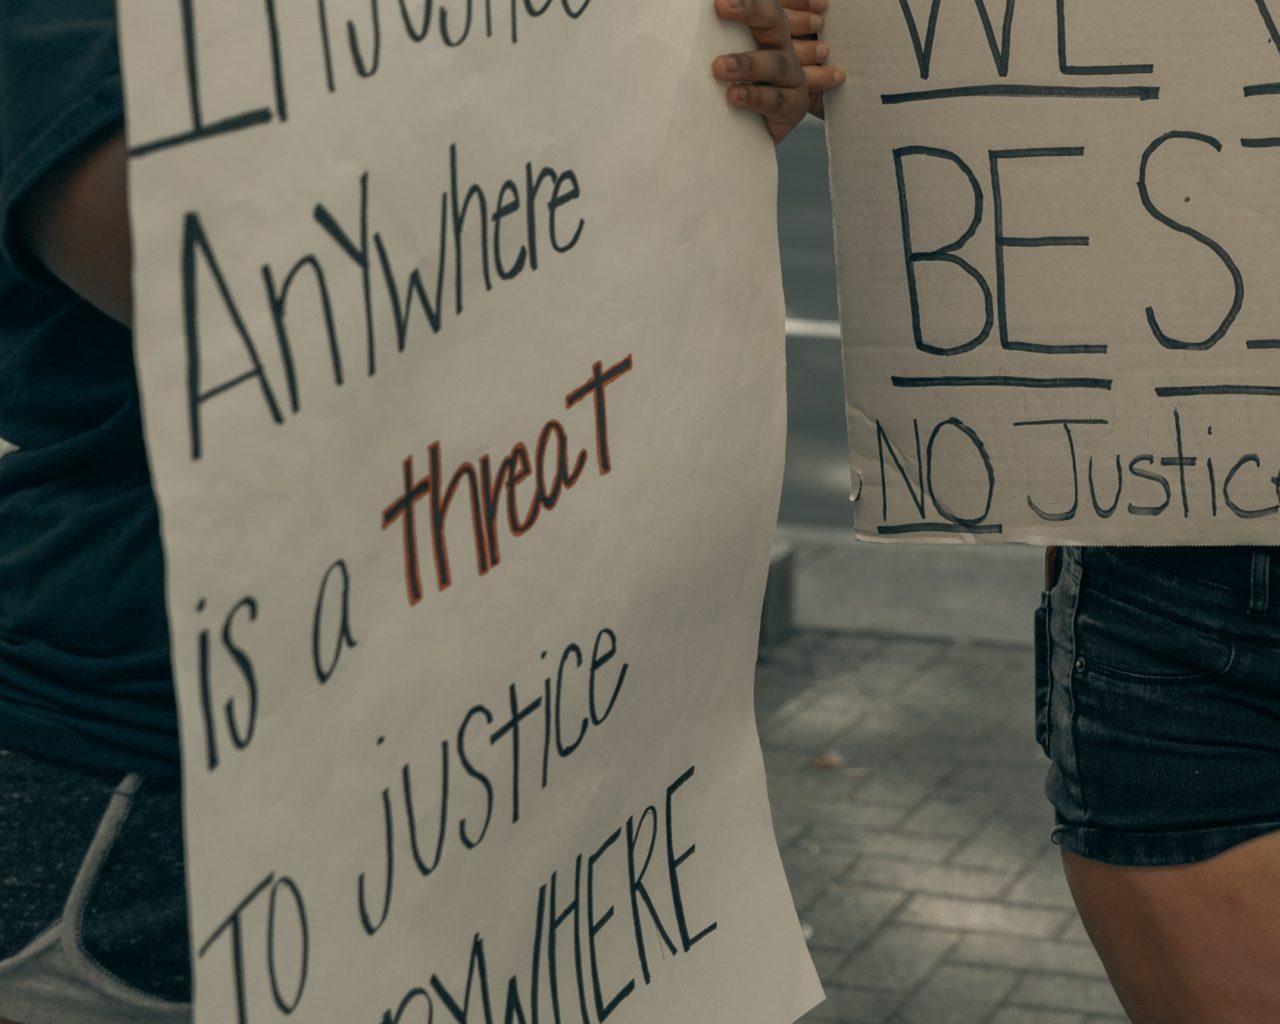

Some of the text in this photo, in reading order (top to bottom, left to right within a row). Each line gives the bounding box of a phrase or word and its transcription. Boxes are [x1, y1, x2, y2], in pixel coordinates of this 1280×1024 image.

[893, 145, 1108, 356] BE
[876, 416, 996, 526] NO
[196, 595, 258, 772] is
[311, 559, 359, 685] a
[199, 871, 310, 1024] TO
